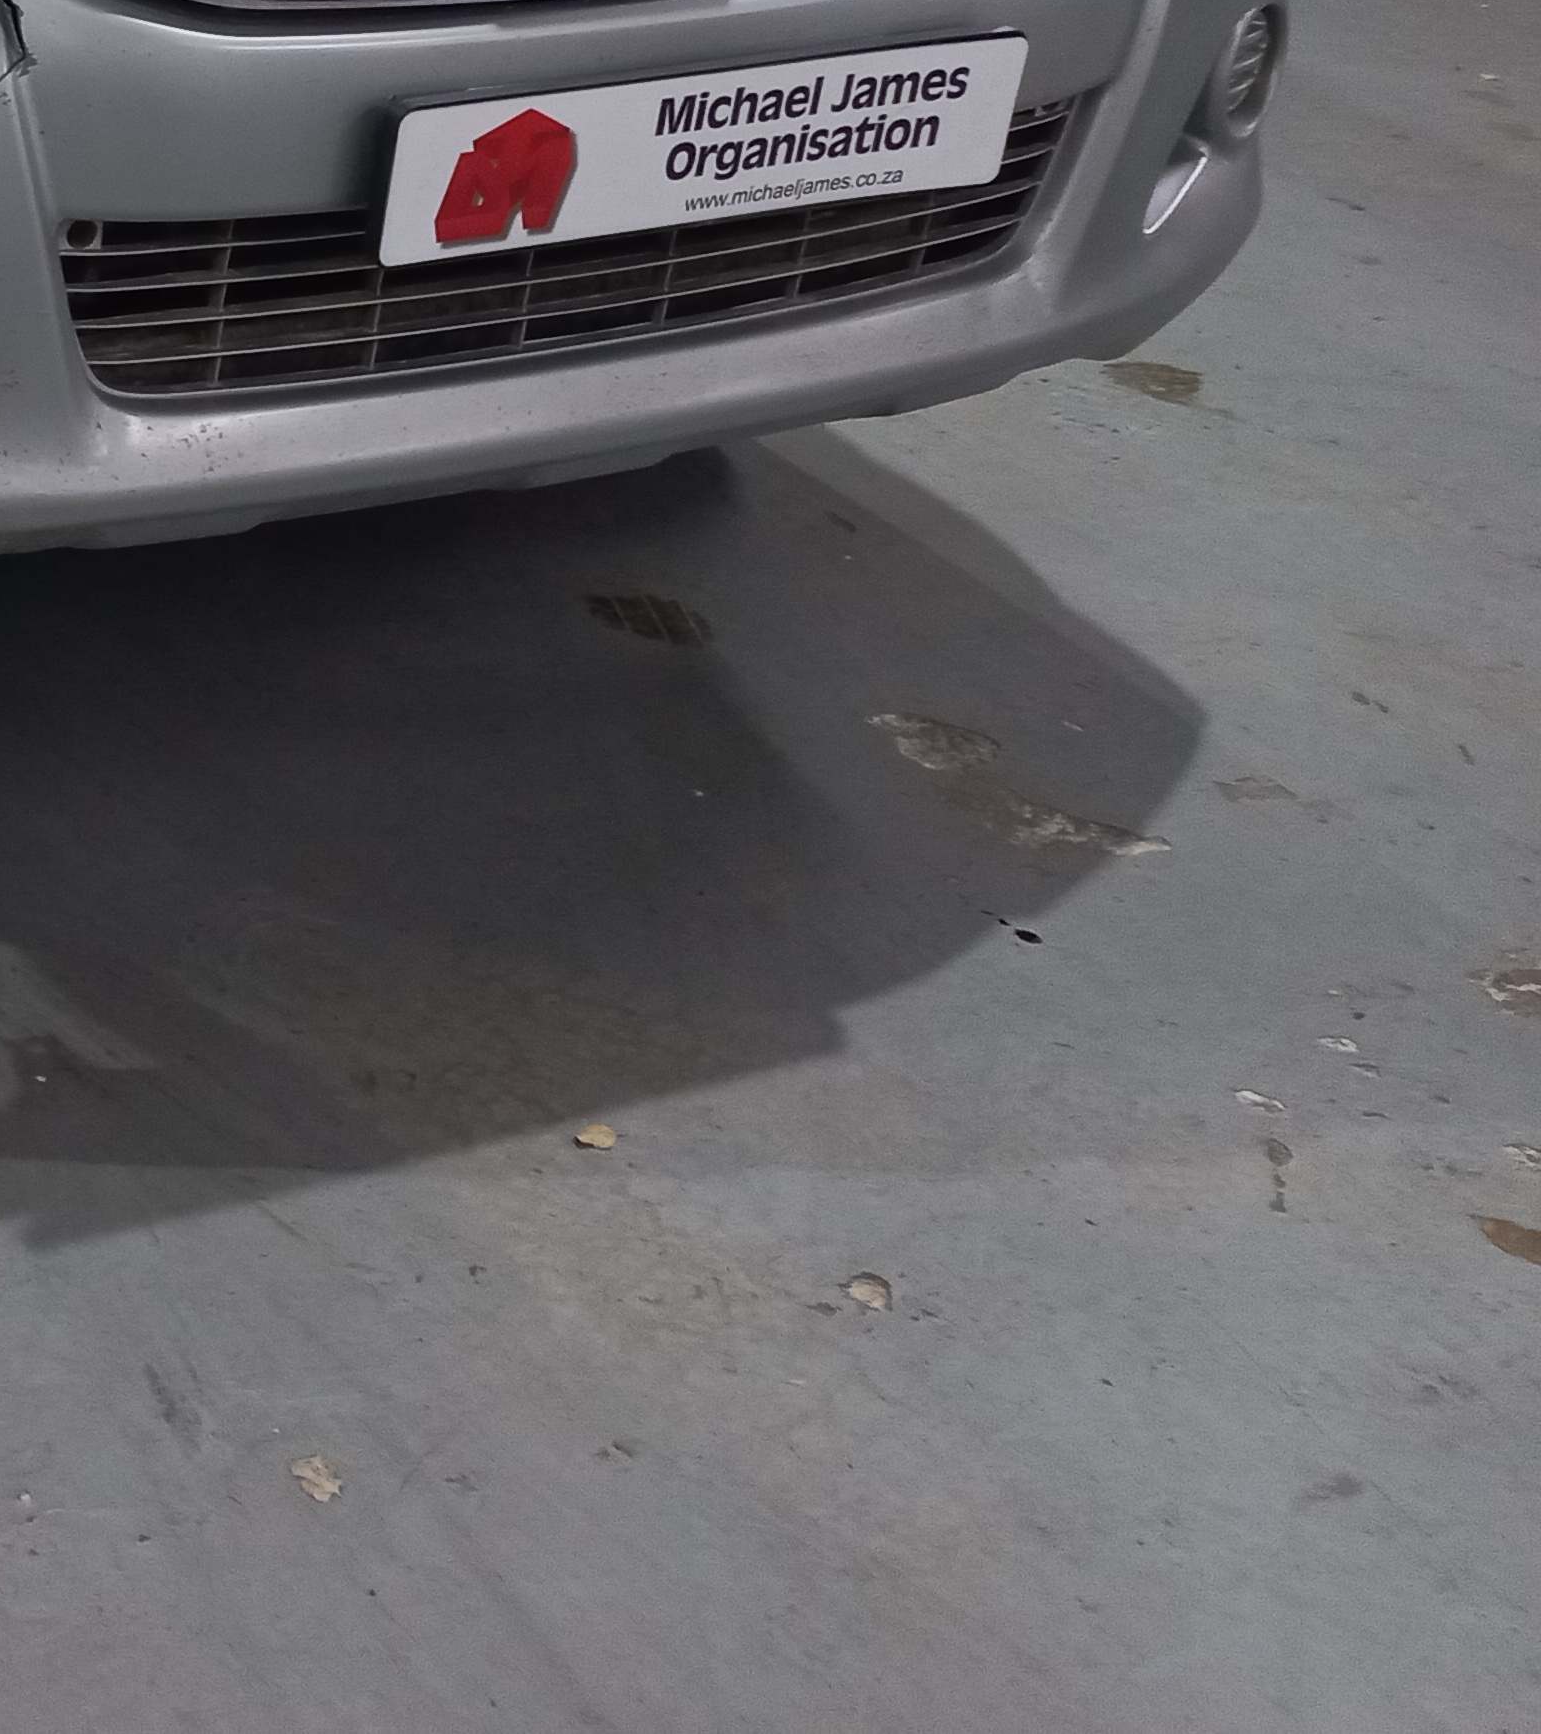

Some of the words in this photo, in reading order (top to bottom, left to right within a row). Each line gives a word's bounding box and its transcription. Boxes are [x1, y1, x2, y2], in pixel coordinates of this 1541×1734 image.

[654, 76, 825, 137] Michael
[830, 65, 971, 114] James
[665, 113, 941, 181] Organisation
[684, 169, 904, 212] www.michaeljames.co.za
